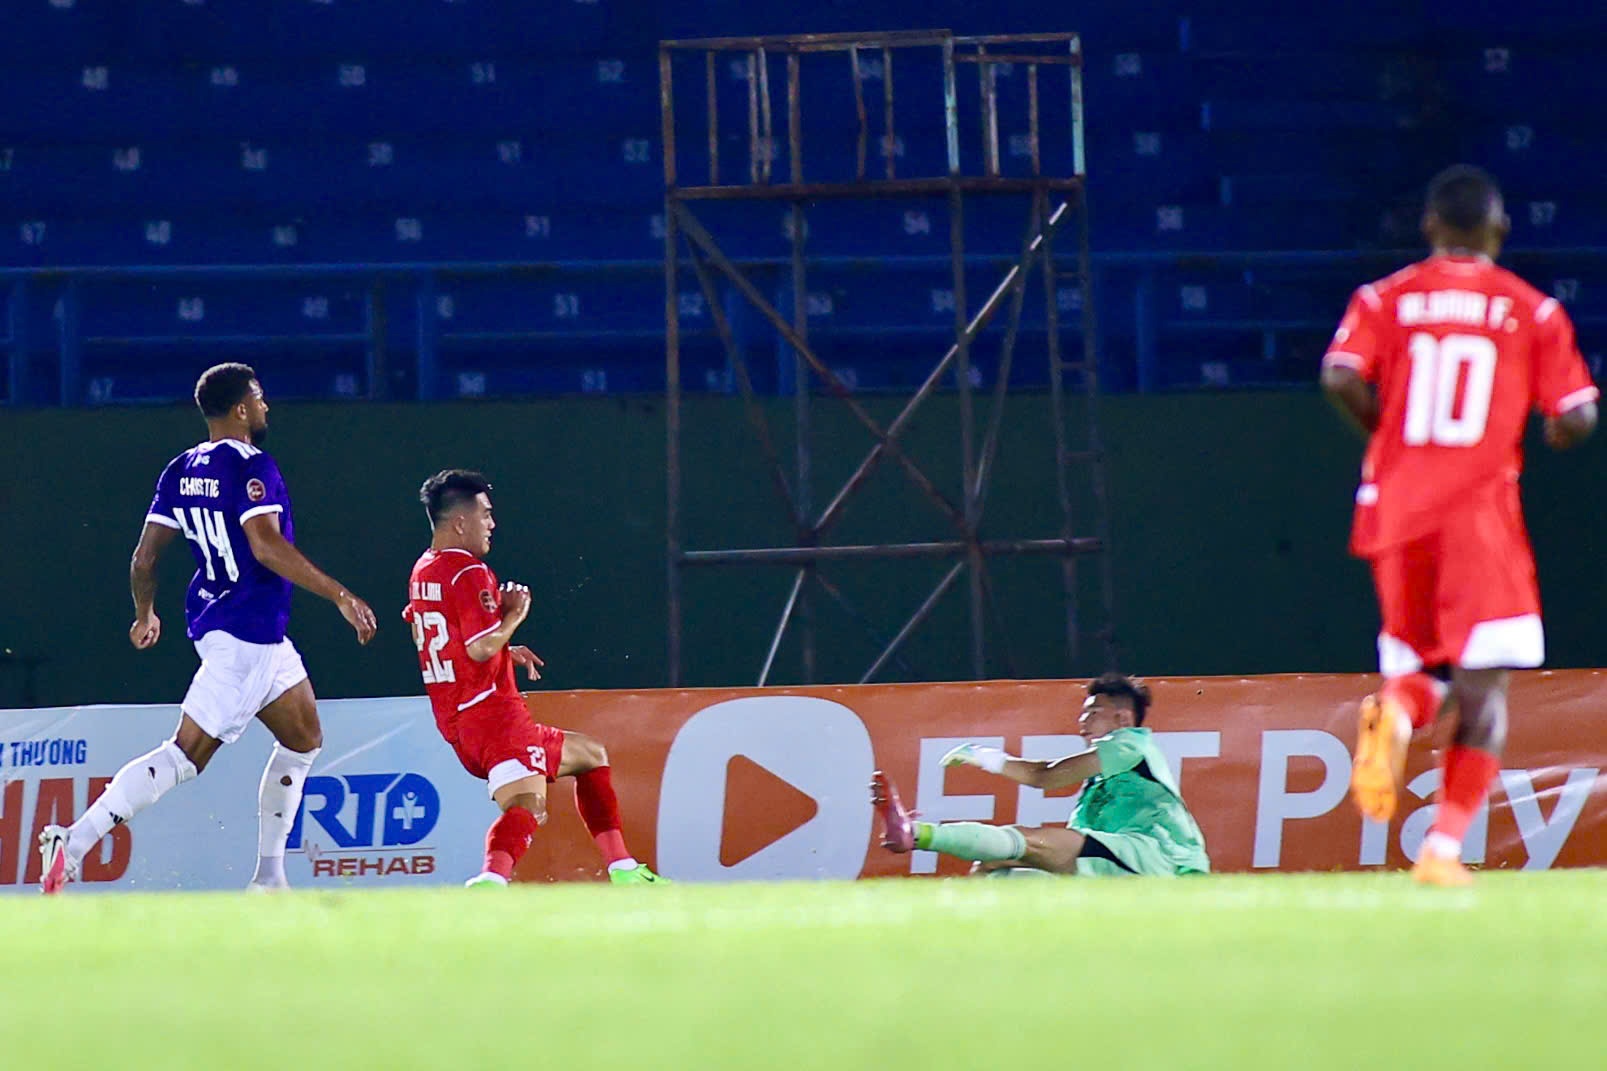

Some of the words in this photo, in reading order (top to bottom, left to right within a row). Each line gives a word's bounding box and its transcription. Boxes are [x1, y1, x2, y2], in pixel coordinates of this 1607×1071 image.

[1402, 332, 1498, 447] 10
[172, 507, 239, 583] 44
[413, 611, 457, 684] 22
[10, 739, 88, 767] THƯƠNG
[312, 854, 436, 877] REHAB
